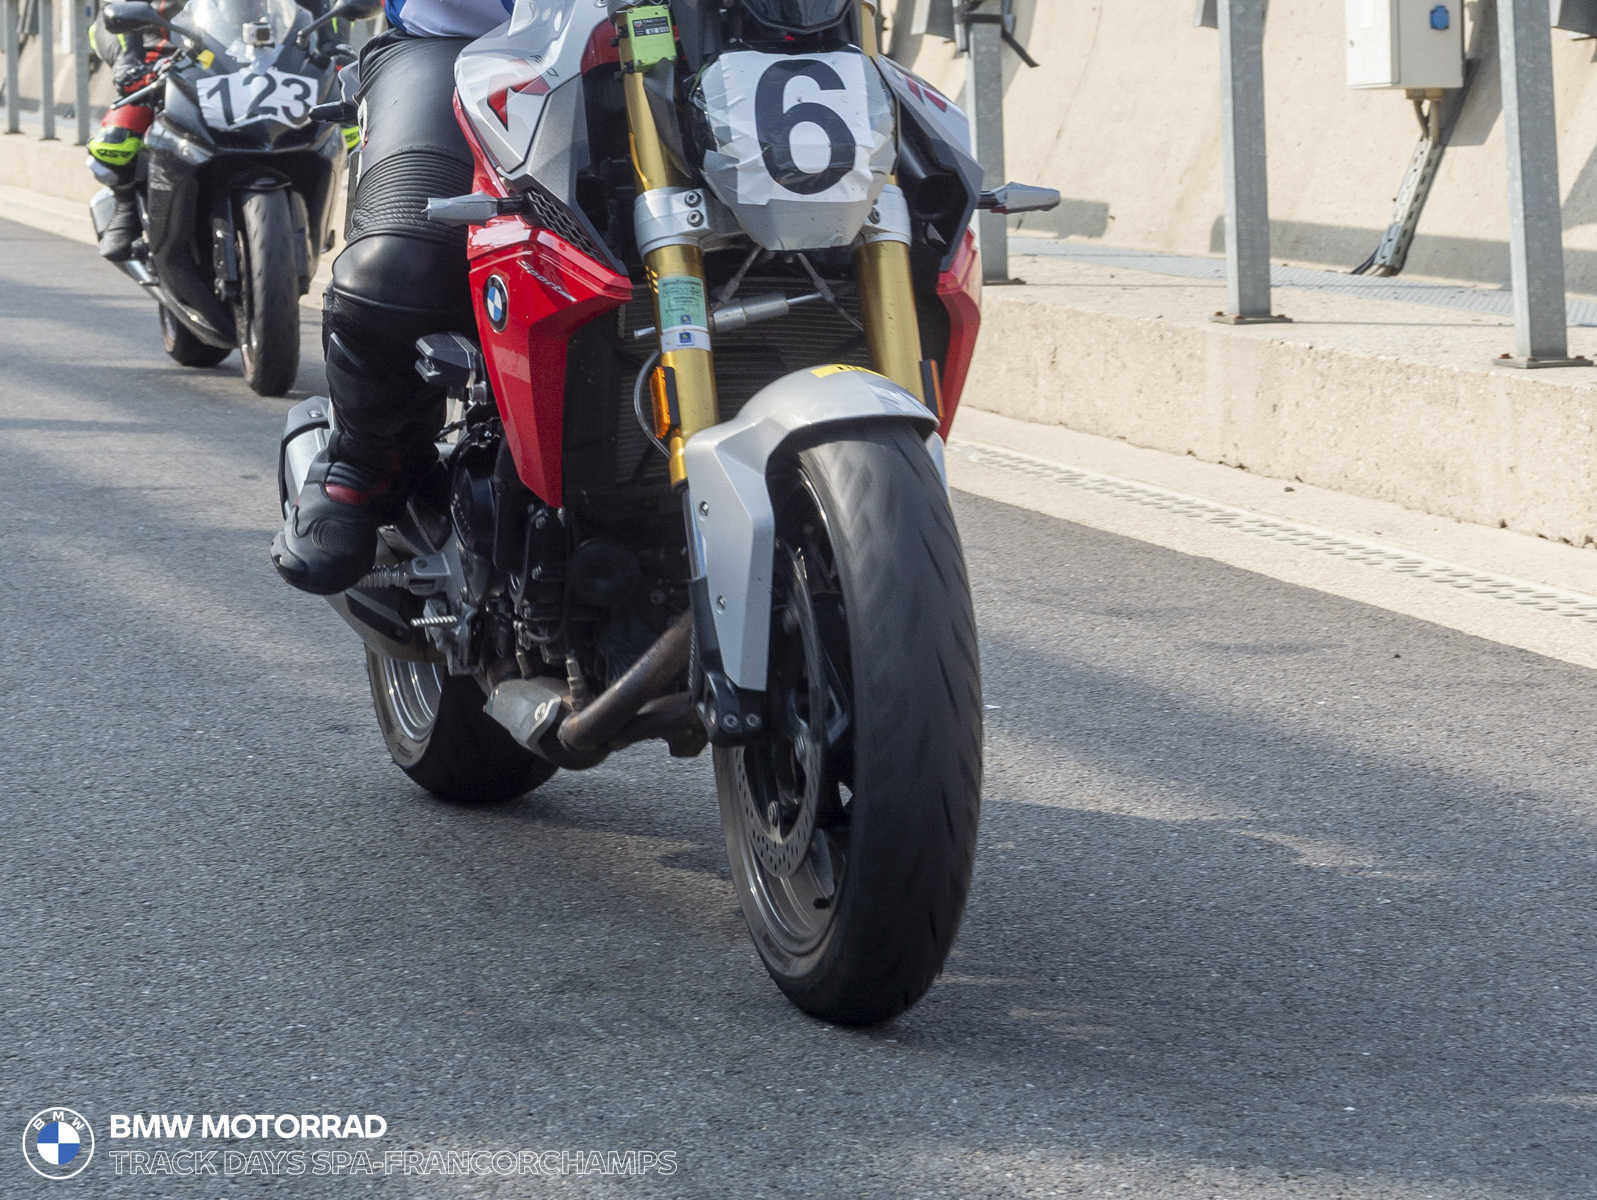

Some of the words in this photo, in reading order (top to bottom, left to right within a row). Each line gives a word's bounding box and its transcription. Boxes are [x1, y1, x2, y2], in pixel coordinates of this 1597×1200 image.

[206, 72, 311, 126] 123
[755, 58, 856, 196] 6
[516, 260, 572, 299] Sport
